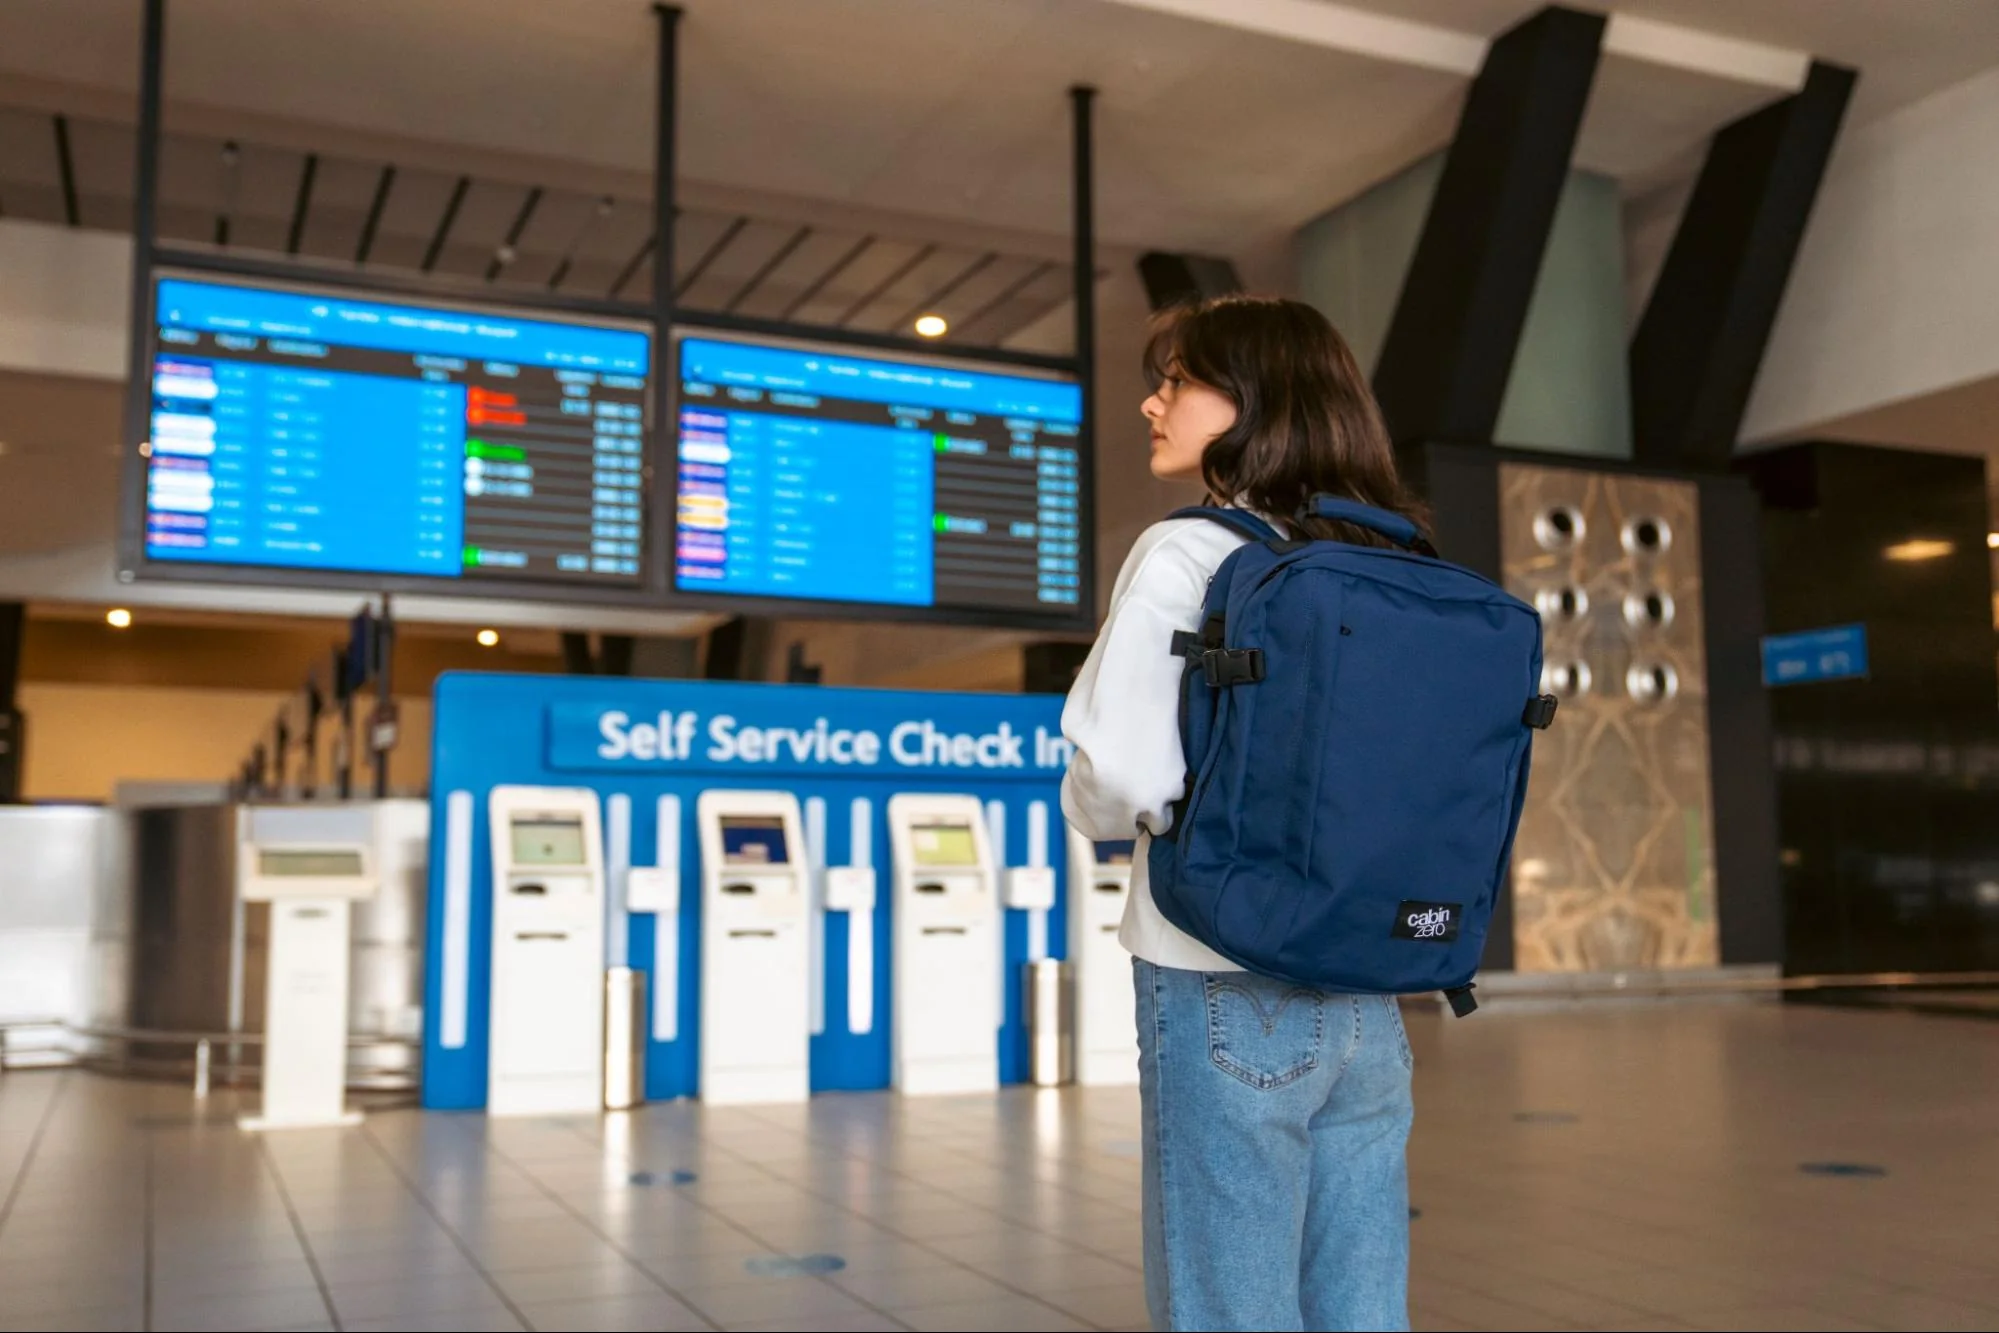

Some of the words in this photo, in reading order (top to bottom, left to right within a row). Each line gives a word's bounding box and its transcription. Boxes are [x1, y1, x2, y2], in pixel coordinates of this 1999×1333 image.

[600, 711, 697, 759] Self
[707, 714, 880, 765] Service
[889, 720, 1024, 768] Check
[1035, 725, 1074, 768] In
[1407, 906, 1450, 927] cabin
[1413, 922, 1446, 938] zero
